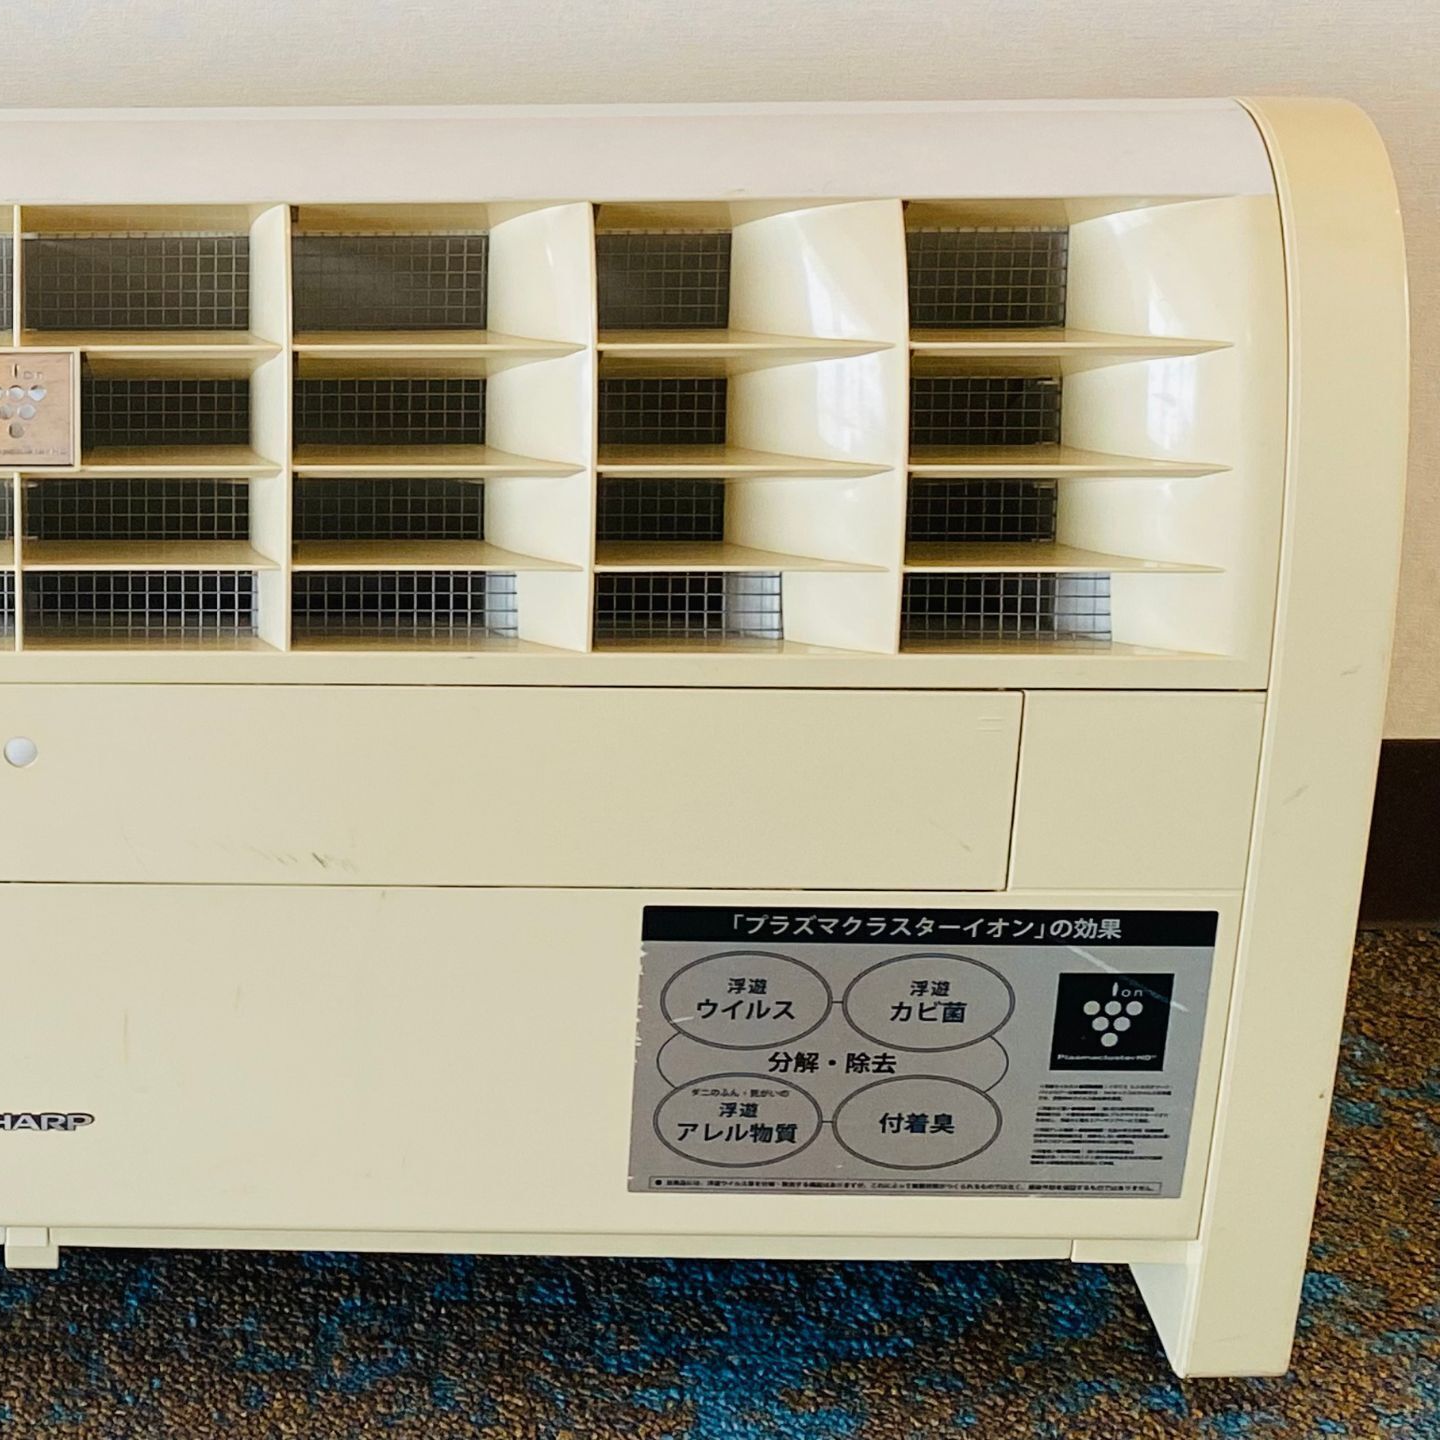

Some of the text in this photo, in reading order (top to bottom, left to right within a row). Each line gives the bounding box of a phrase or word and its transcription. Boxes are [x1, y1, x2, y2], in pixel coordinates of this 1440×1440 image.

[733, 914, 1122, 939] 「プラズマクラスターイオン」の効果
[727, 978, 767, 995] 浮遊
[910, 980, 950, 997] 浮遊
[696, 999, 796, 1020] ウイルス
[890, 1001, 967, 1023] カビ菌
[768, 1051, 897, 1074] 分解・除去
[719, 1102, 759, 1119] 浮遊
[677, 1123, 798, 1144] アレル物質
[879, 1113, 956, 1135] 付着臭
